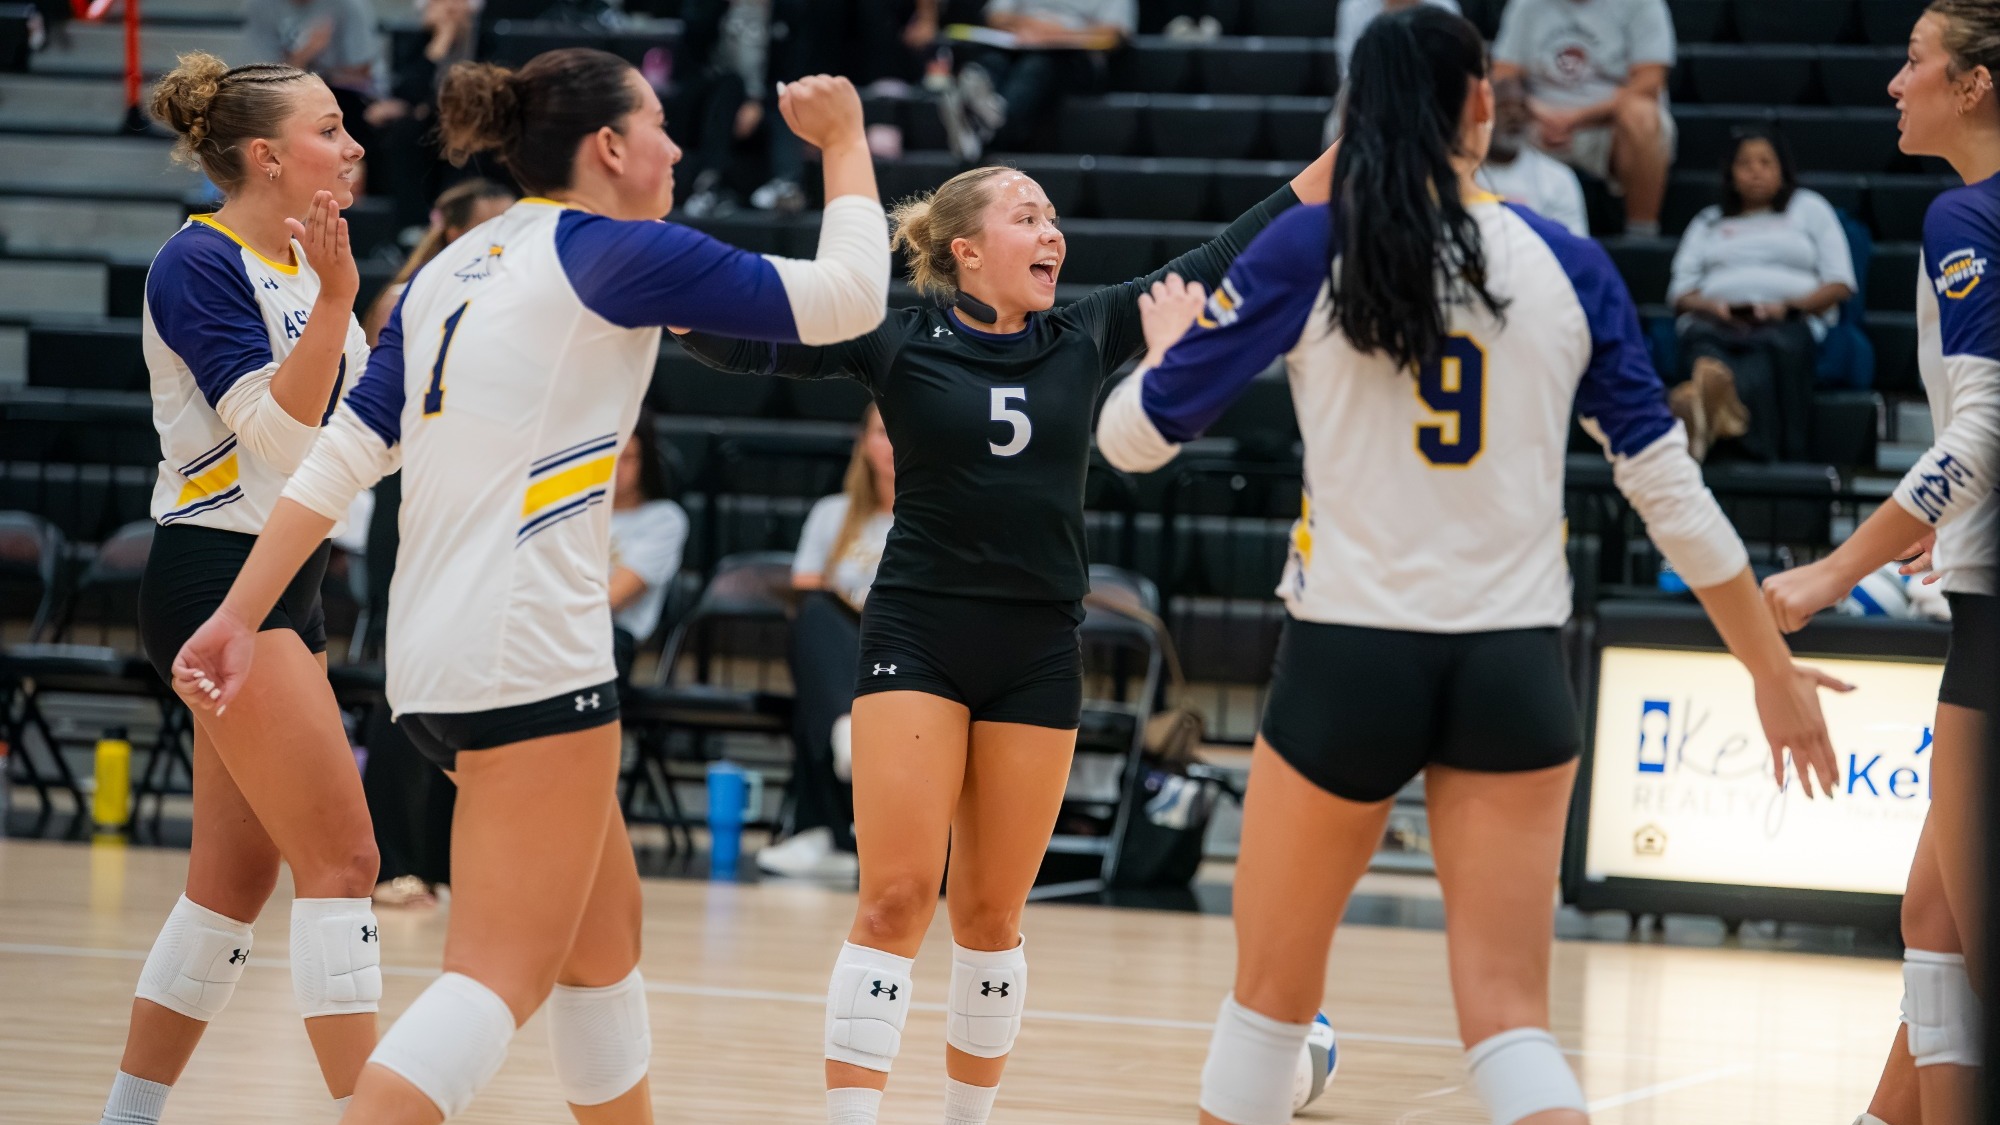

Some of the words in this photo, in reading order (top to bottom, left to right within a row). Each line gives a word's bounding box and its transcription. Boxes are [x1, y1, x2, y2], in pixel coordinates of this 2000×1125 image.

[422, 297, 472, 419] 1
[1413, 331, 1487, 470] 9
[986, 385, 1034, 458] 5
[1846, 752, 1933, 801] Ke
